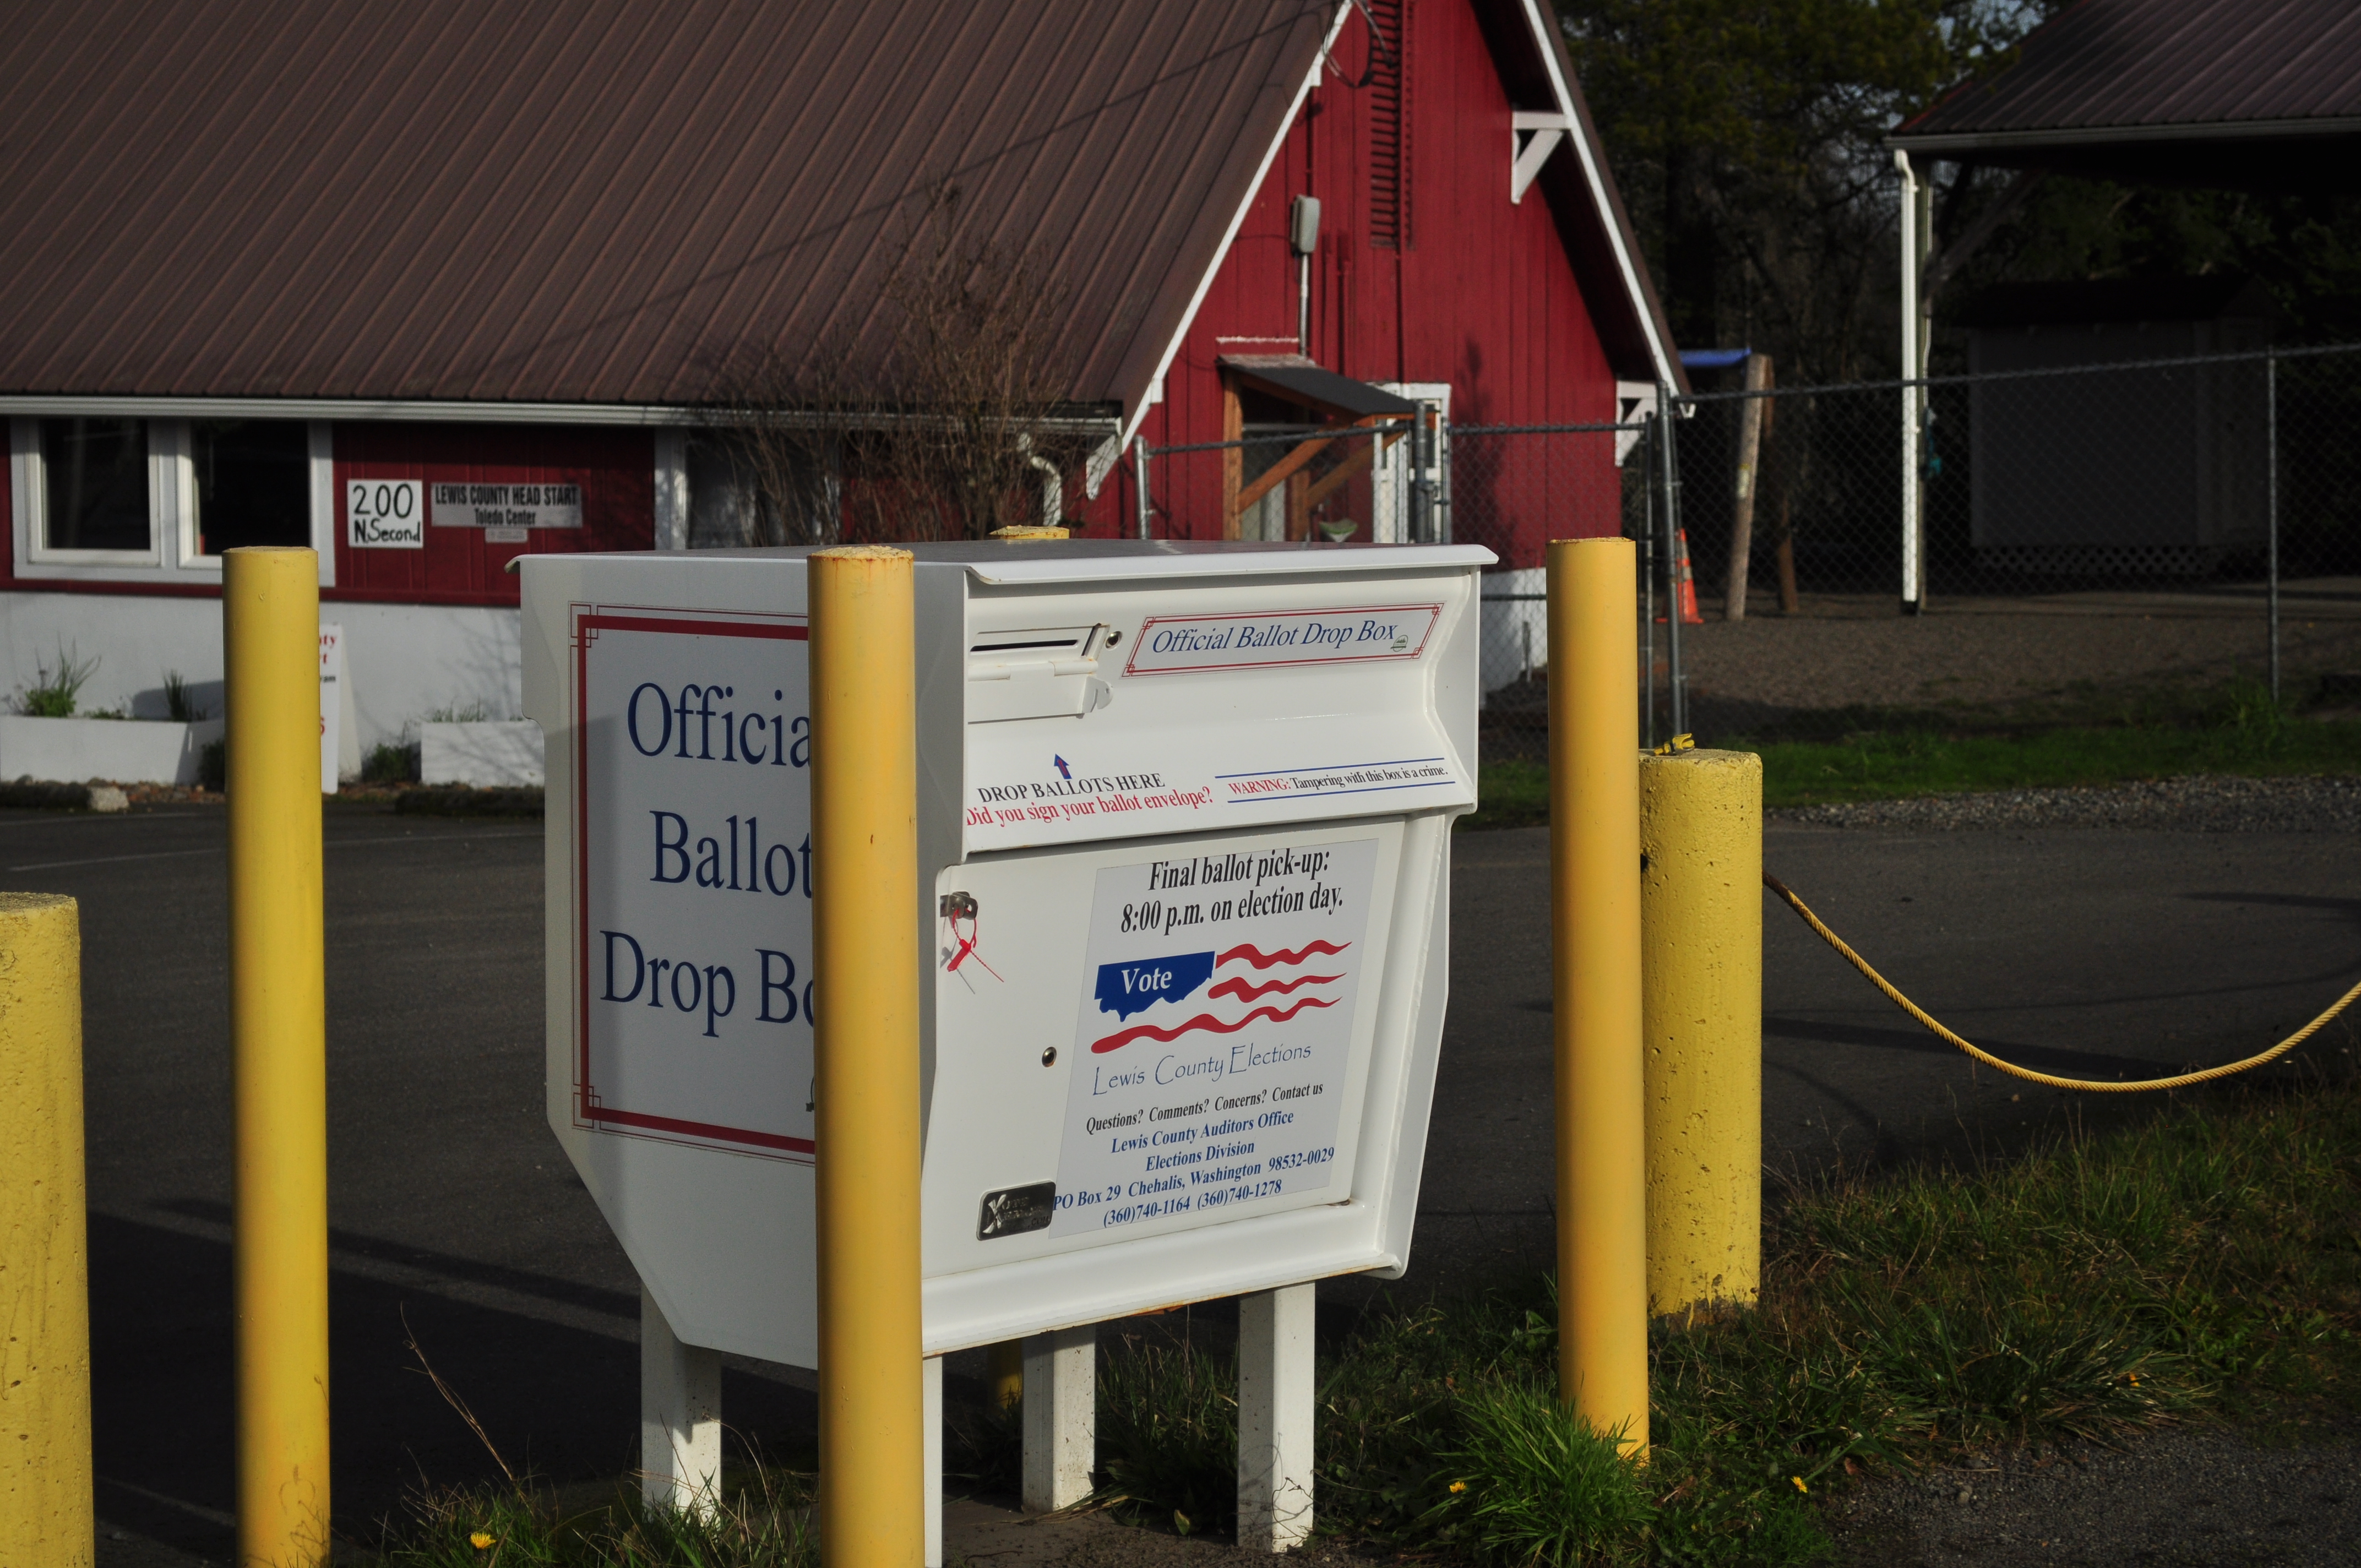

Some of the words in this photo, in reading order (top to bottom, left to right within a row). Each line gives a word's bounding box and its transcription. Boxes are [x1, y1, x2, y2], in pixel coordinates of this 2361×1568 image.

[353, 484, 413, 518] 200
[435, 485, 467, 504] LEWIS
[470, 486, 509, 505] COUNTY
[513, 487, 541, 505] HEAD
[544, 487, 577, 505] START
[475, 508, 504, 525] Toledo
[505, 508, 536, 525] Center
[1152, 627, 1234, 652] Official
[1234, 624, 1299, 648] Ballot
[1301, 623, 1353, 649] Drop
[1356, 620, 1398, 641] Box
[627, 682, 812, 768] Officia
[977, 786, 1027, 803] DROP
[1030, 777, 1114, 797] BALLOTS
[1114, 773, 1165, 791] HERE
[1228, 778, 1291, 795] WARNING:
[1290, 774, 1346, 790] Tampering
[1344, 771, 1366, 783] with
[1365, 770, 1384, 782] this
[1384, 769, 1402, 780] box
[1401, 767, 1411, 778] is
[1411, 769, 1418, 777] a
[1418, 765, 1448, 776] crime.
[994, 808, 1026, 827] you
[1026, 802, 1060, 823] sign
[1060, 800, 1096, 820] your
[1096, 794, 1143, 813] ballot
[1144, 786, 1214, 809] envelope?
[650, 810, 812, 900] Ballot
[1147, 858, 1198, 891] Final
[1201, 853, 1253, 885] ballot
[1255, 848, 1330, 887] pick-up:
[1121, 900, 1161, 933] 8:00
[1163, 902, 1205, 936] p.m.
[1211, 900, 1233, 922] on
[1238, 885, 1304, 919] election
[1309, 881, 1343, 916] day.
[600, 930, 735, 1038] Drop
[1121, 967, 1172, 994] Vote
[1092, 1066, 1145, 1096] Lewis
[1155, 1054, 1224, 1086] County
[1229, 1042, 1312, 1074] Elections
[1086, 1109, 1144, 1135] Questions?
[1149, 1098, 1210, 1123] Comments?
[1215, 1089, 1267, 1112] Concerns?
[1272, 1085, 1311, 1102] Contact
[1312, 1082, 1324, 1095] us
[1111, 1136, 1148, 1154] Lewis
[1152, 1126, 1198, 1146] County
[1200, 1115, 1254, 1138] Auditors
[1258, 1110, 1294, 1129] Office
[1145, 1150, 1202, 1172] Elections
[1205, 1141, 1255, 1162] Division
[1053, 1194, 1074, 1211] PO
[1077, 1191, 1102, 1207] Box
[1105, 1185, 1121, 1202] 29
[1128, 1174, 1186, 1198] Chehalis,
[1190, 1163, 1261, 1186] Washington
[1267, 1146, 1335, 1173] 98532-0029
[1103, 1196, 1191, 1228] (360)740-1164
[1197, 1179, 1282, 1211] (360)740-1278
